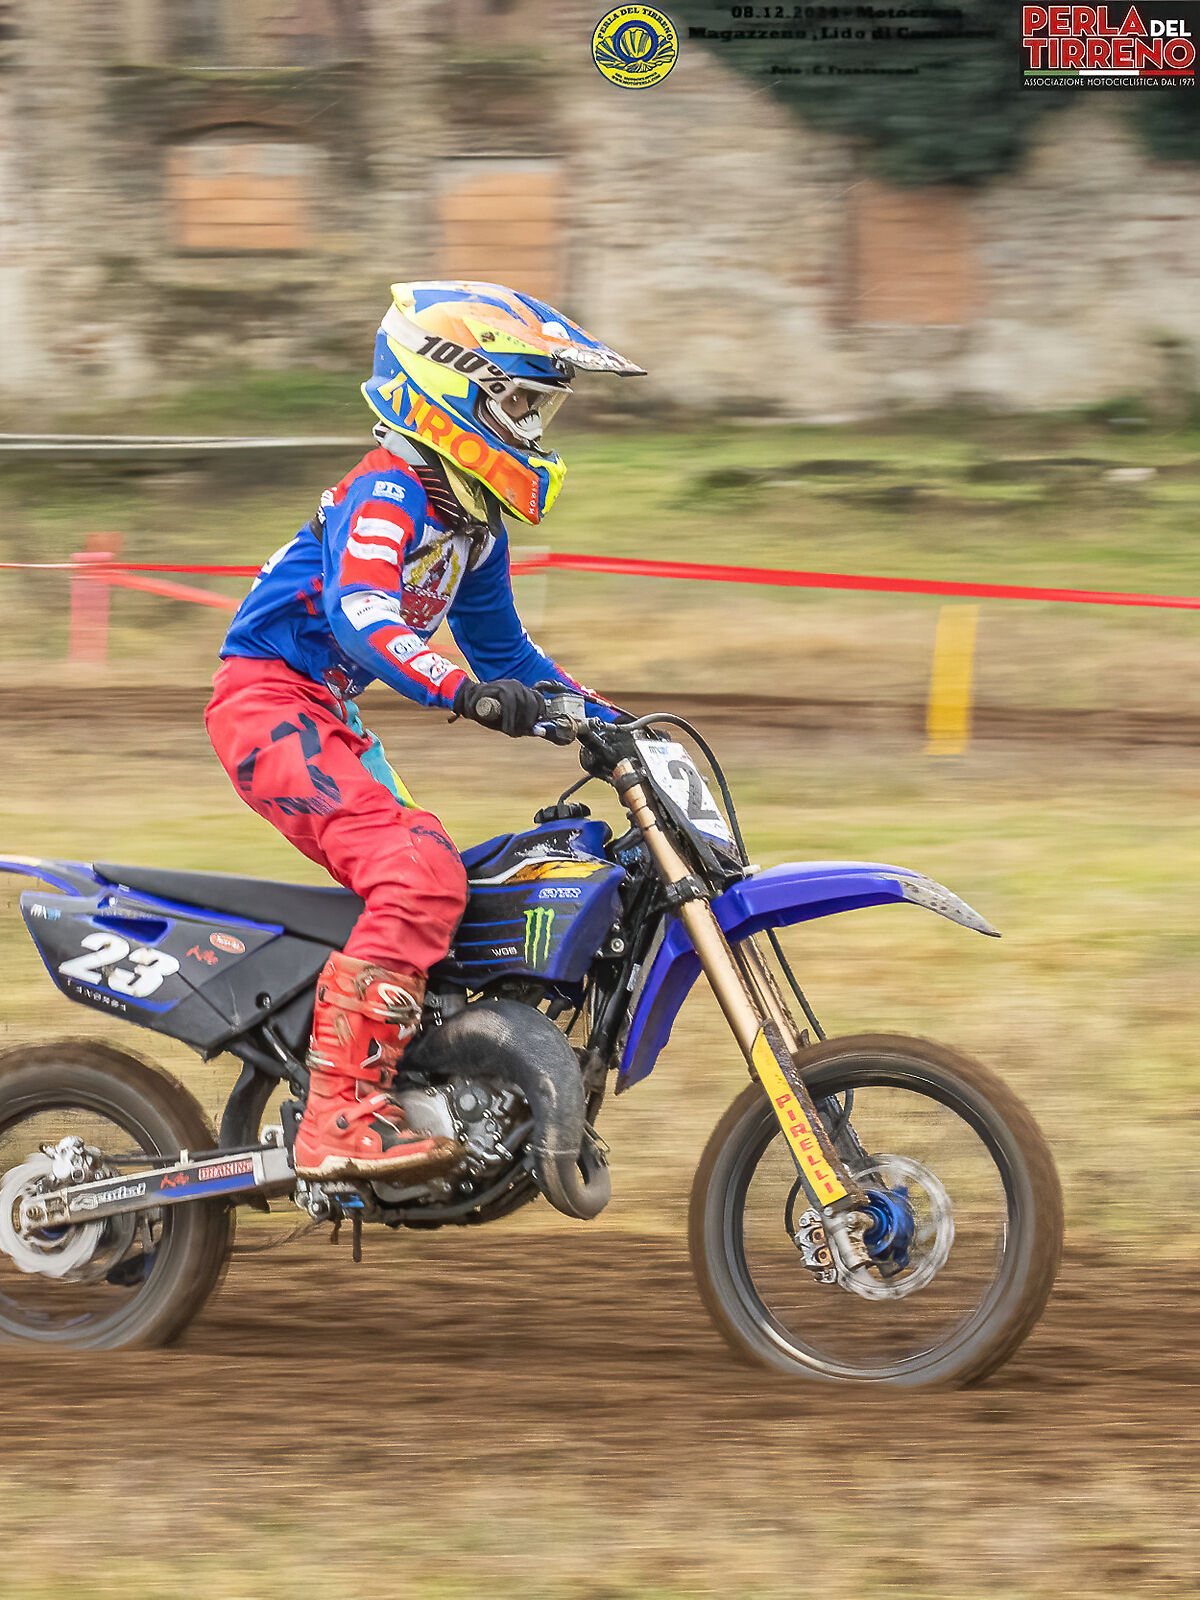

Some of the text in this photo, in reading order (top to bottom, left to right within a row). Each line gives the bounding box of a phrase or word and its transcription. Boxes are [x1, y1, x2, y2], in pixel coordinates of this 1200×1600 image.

[416, 336, 513, 395] 100%
[58, 932, 181, 998] 23
[775, 1093, 834, 1194] PIRELLI
